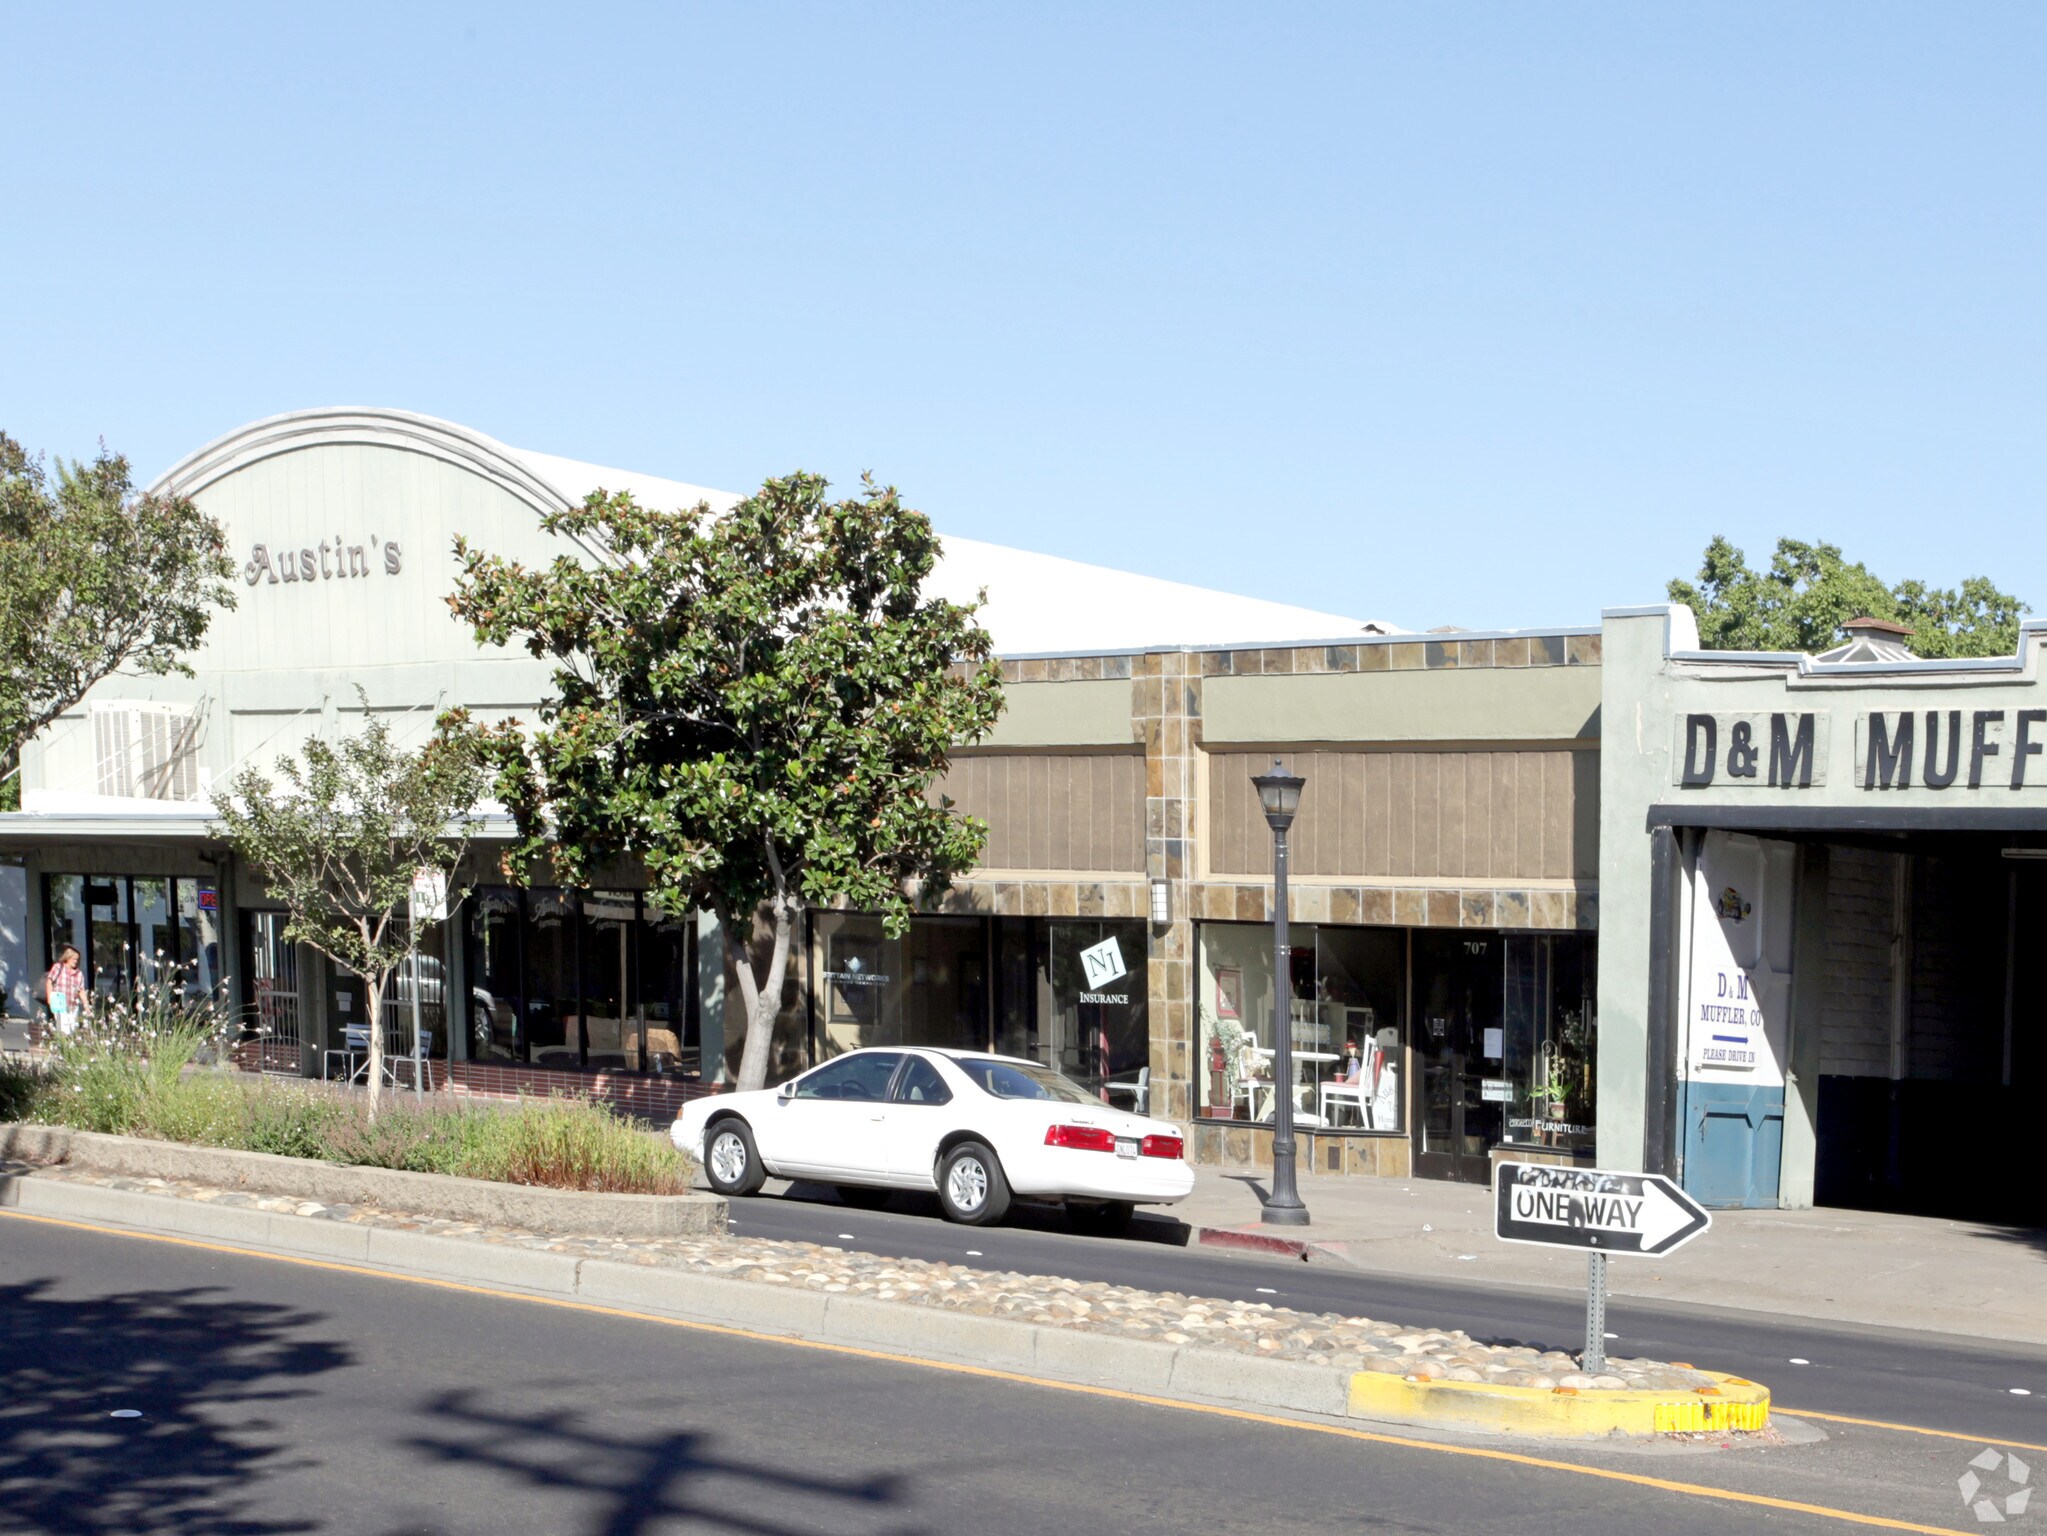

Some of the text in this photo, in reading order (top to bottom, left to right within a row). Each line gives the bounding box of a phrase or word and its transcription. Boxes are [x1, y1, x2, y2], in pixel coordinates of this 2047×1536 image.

[245, 534, 402, 586] Austin's
[1681, 710, 2047, 791] D&M MUFF
[1463, 941, 1488, 955] 707
[852, 973, 890, 983] NETWORKS
[1717, 972, 1727, 998] D
[1737, 974, 1748, 1000] M
[1079, 991, 1129, 1004] INSURANCE
[1703, 1047, 1756, 1063] PLEASE DRIVE IN
[1535, 1119, 1587, 1135] FURNITURE
[1516, 1188, 1644, 1229] ONE WAY
